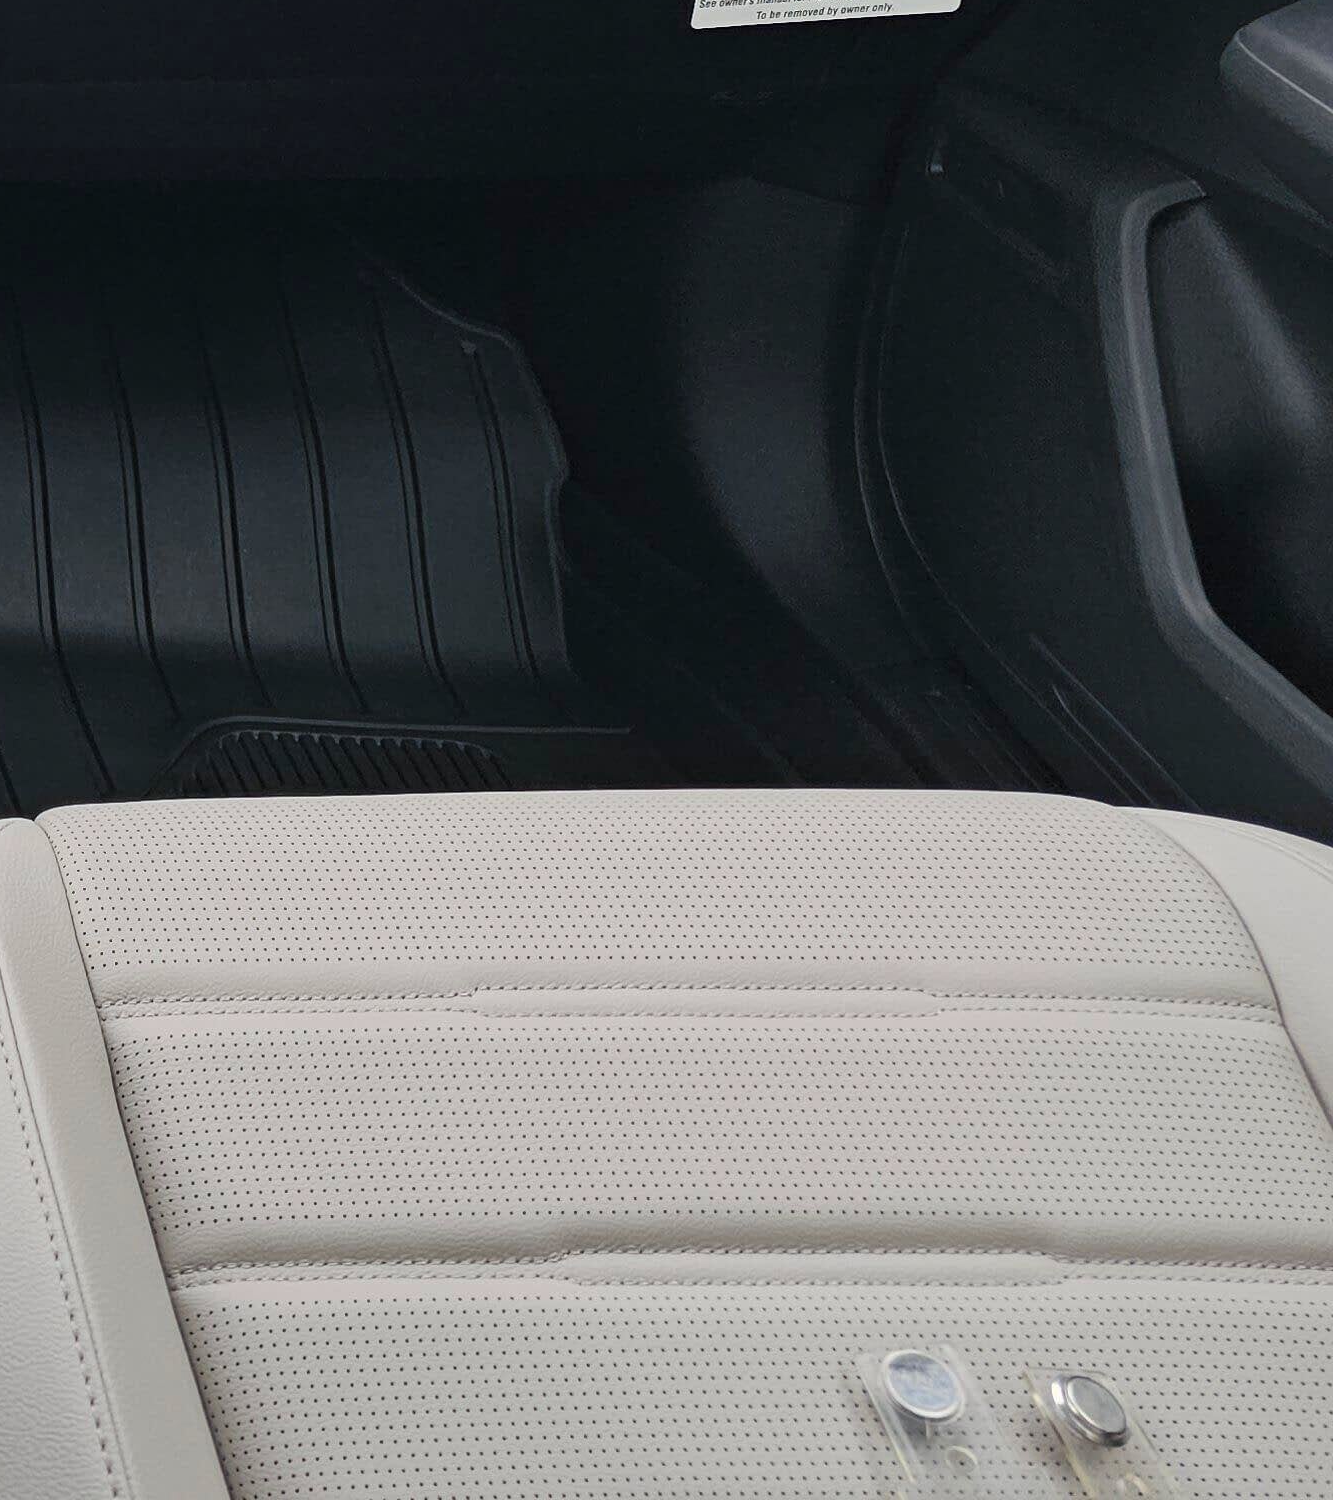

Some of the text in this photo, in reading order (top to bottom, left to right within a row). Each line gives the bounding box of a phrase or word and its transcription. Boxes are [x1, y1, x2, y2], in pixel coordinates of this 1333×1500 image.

[699, 0, 717, 9] See
[756, 11, 767, 20] To
[769, 10, 781, 19] be
[783, 7, 825, 18] removed
[827, 5, 839, 17] by
[840, 4, 871, 15] owner
